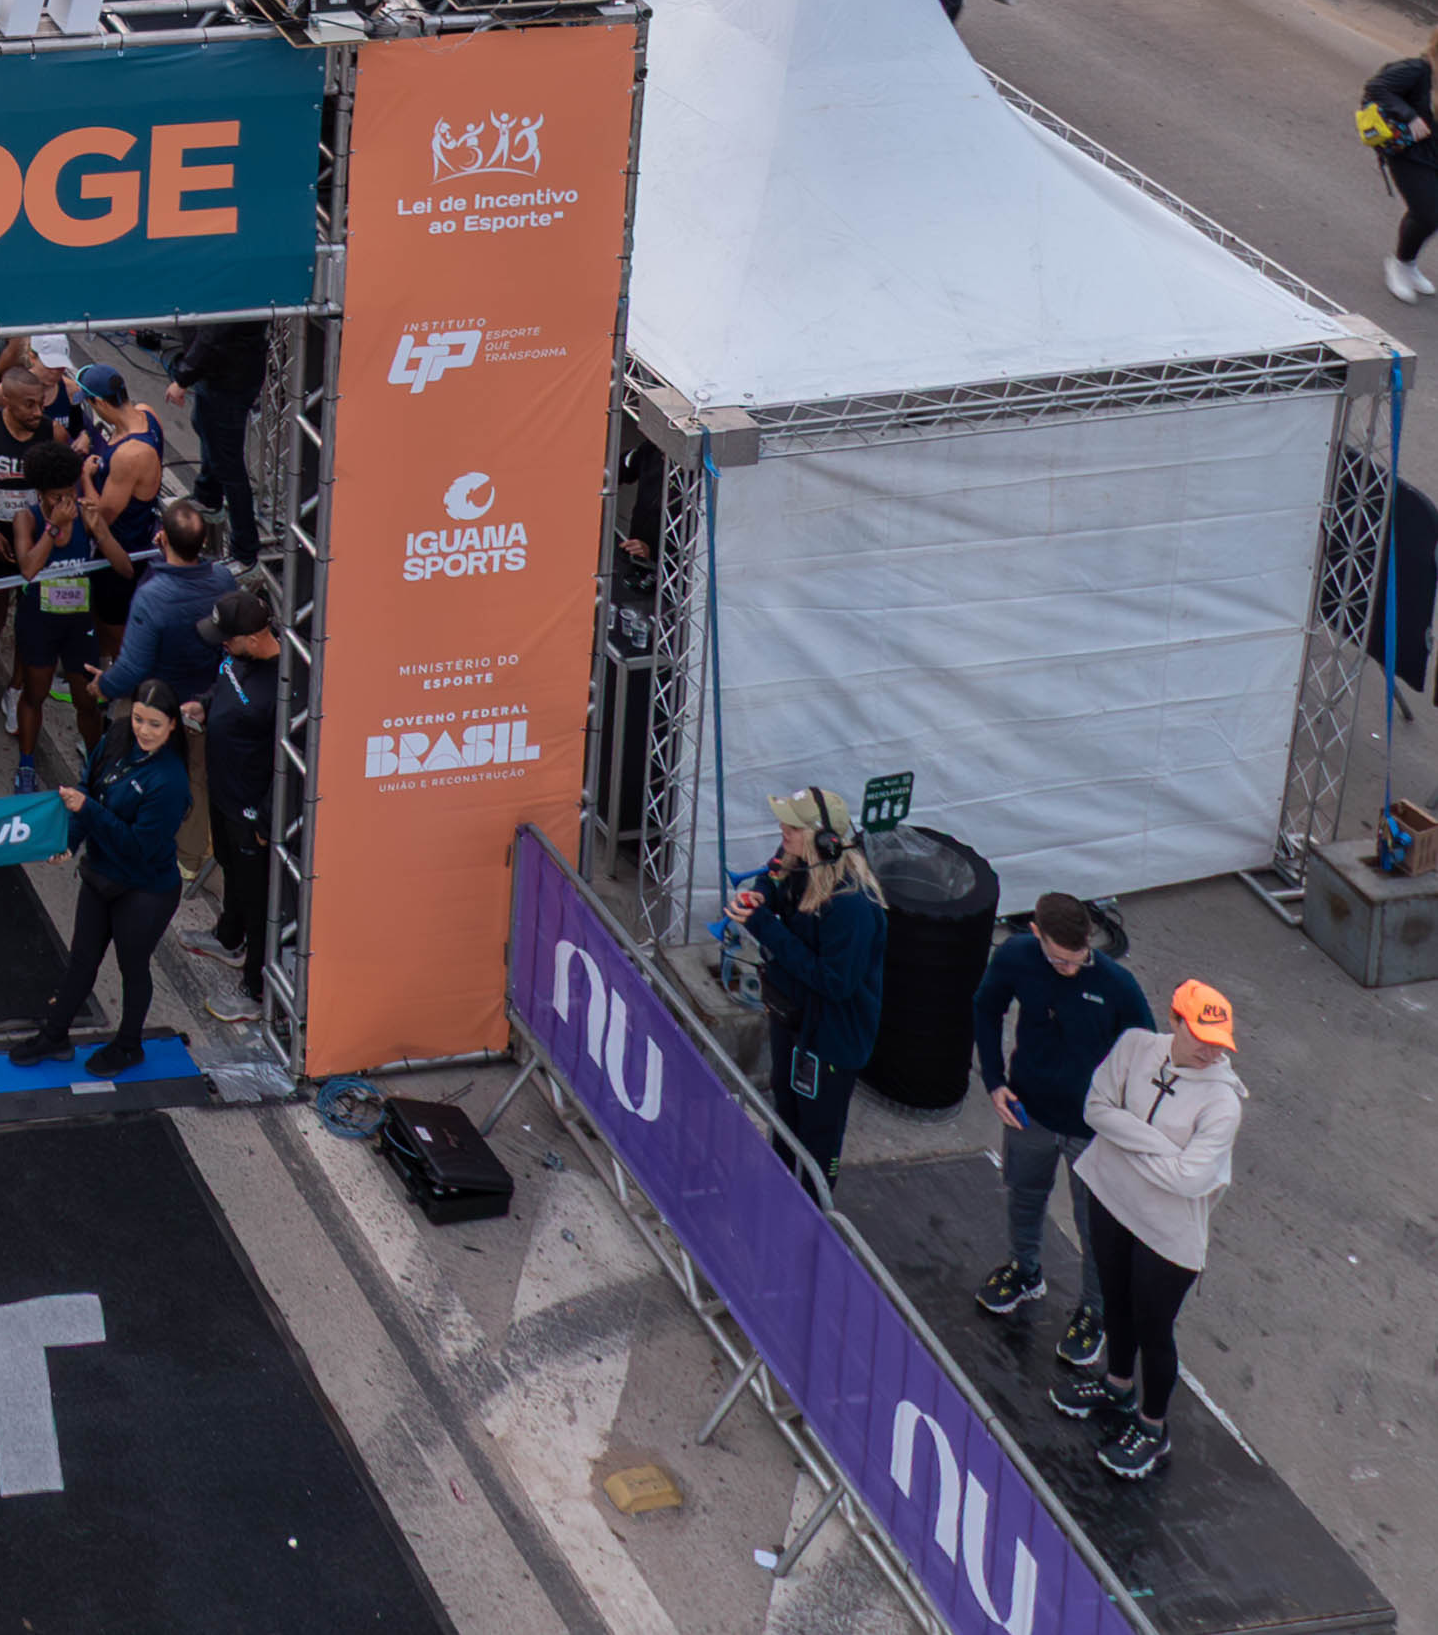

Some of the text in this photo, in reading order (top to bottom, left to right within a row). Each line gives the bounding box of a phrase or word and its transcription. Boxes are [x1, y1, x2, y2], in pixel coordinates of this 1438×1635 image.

[397, 188, 579, 216] Lei de Incentivo
[428, 212, 553, 235] ao Esporte
[403, 317, 487, 333] INSTITUTO
[485, 326, 541, 341] ESPORTE
[484, 339, 510, 352] QUE
[484, 346, 567, 363] TRANSFORMA
[406, 522, 529, 557] IGUANA
[402, 547, 527, 582] SPORTS
[399, 654, 520, 677] MINISTÉRIO DO
[423, 673, 494, 691] ESPORTE
[382, 703, 530, 729] GOVERNO FEDERAL
[365, 720, 541, 779] BRASIL
[378, 778, 417, 794] UNIÃO
[431, 768, 526, 788] RECONSTRUÇÃO
